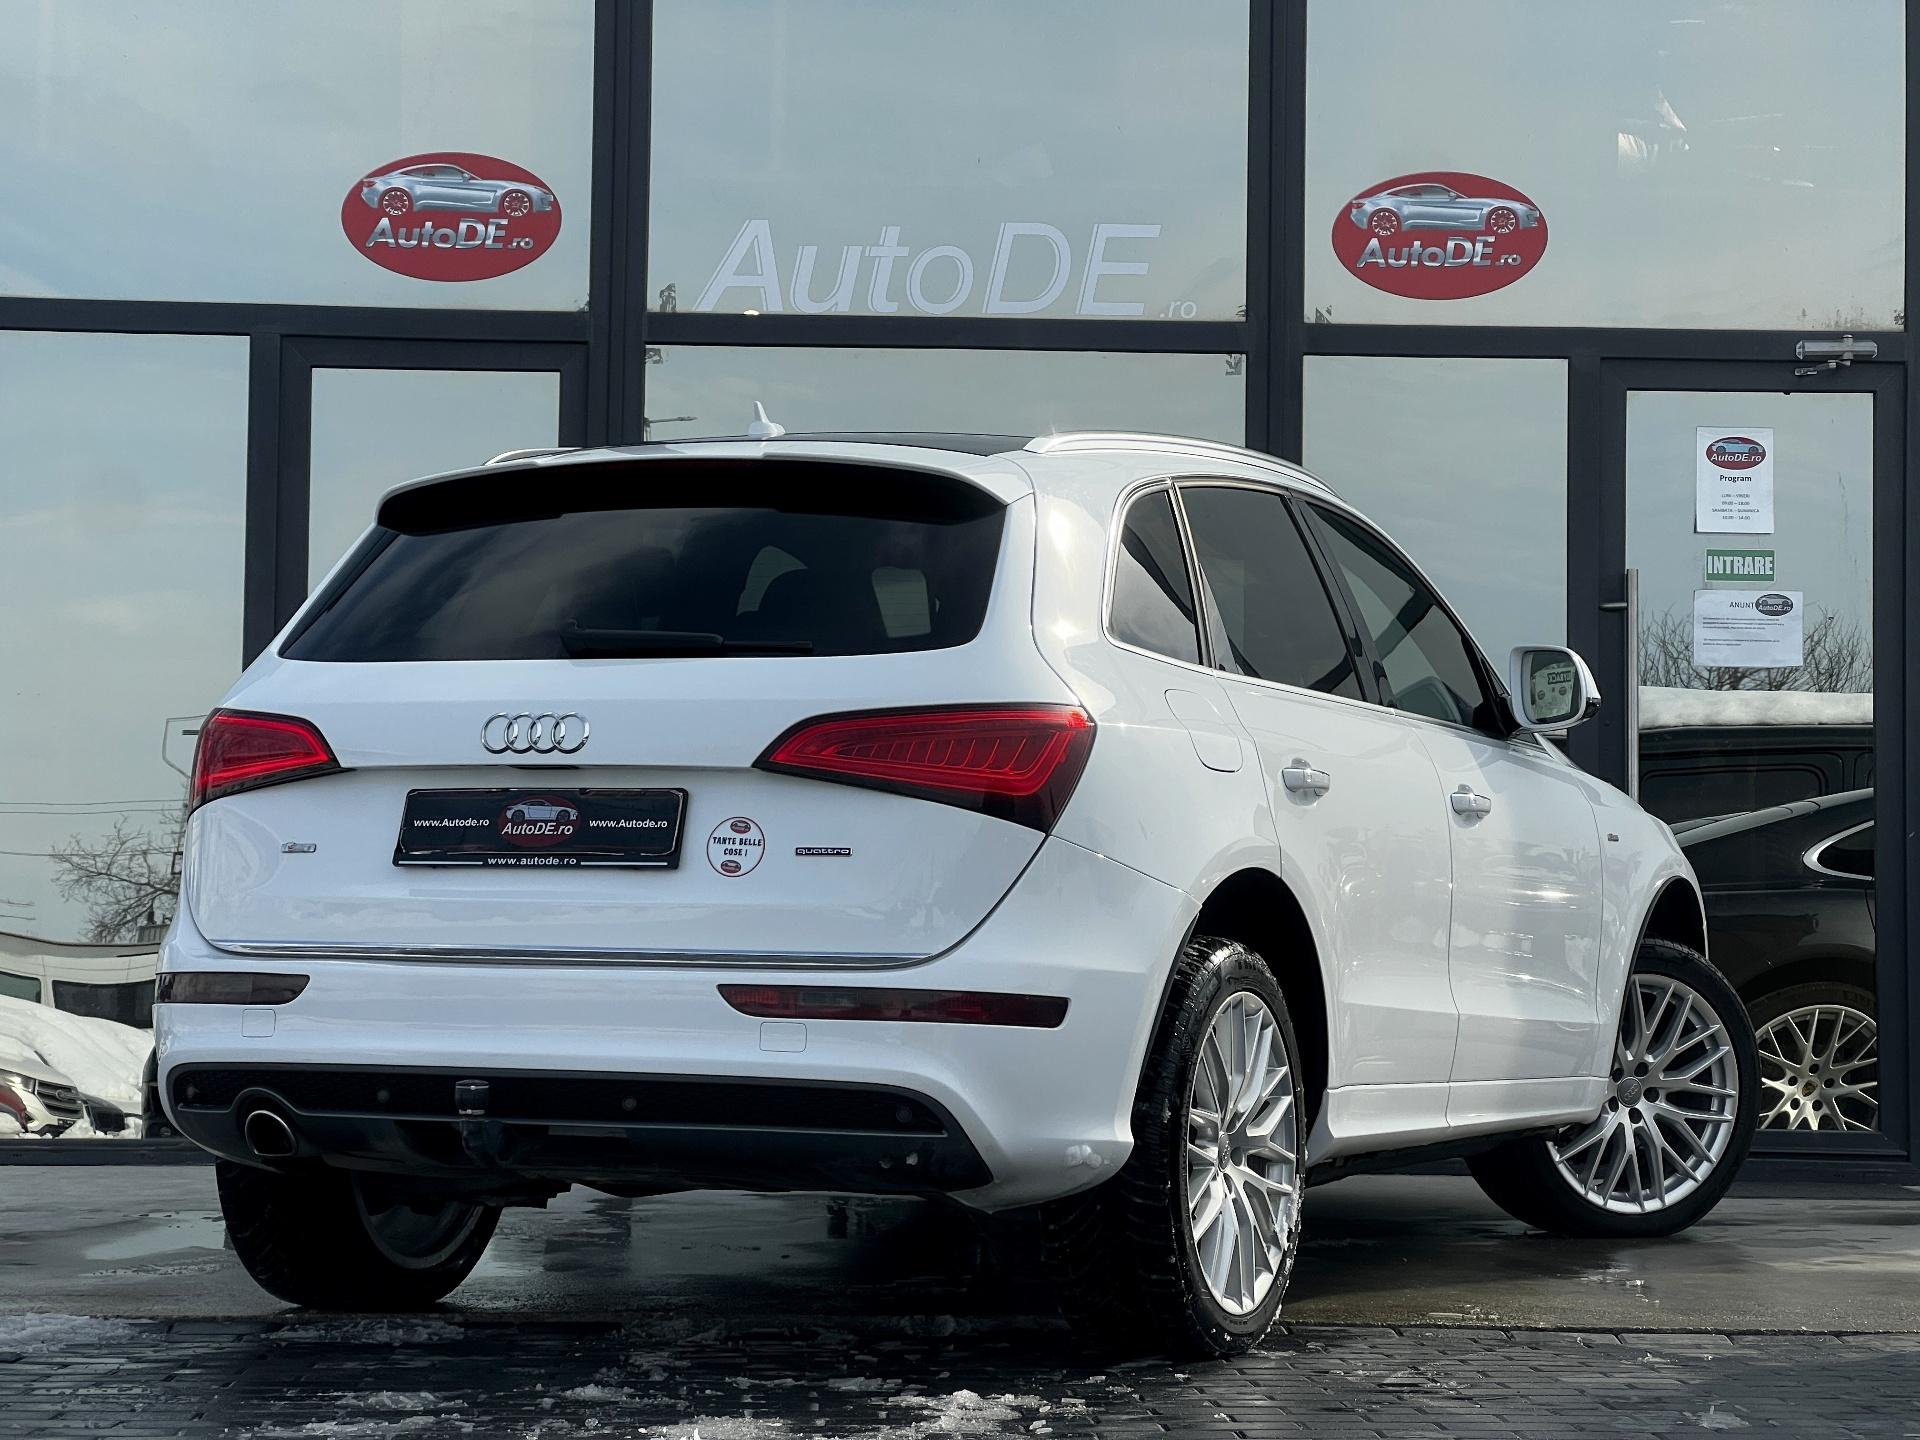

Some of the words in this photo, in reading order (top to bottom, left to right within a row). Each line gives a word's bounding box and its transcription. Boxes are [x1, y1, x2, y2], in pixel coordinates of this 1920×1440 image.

[1710, 453, 1762, 462] AutoDE.ro
[1719, 474, 1752, 483] Program
[1707, 555, 1774, 575] INTRARE
[413, 817, 490, 828] www.Autode.ro
[588, 818, 668, 829] www.Autode.ro
[501, 822, 574, 836] AutoDE.ro
[712, 836, 737, 846] TANTE
[738, 837, 763, 847] BELLE
[723, 847, 743, 856] COSE
[487, 856, 577, 866] www.autode.ro
